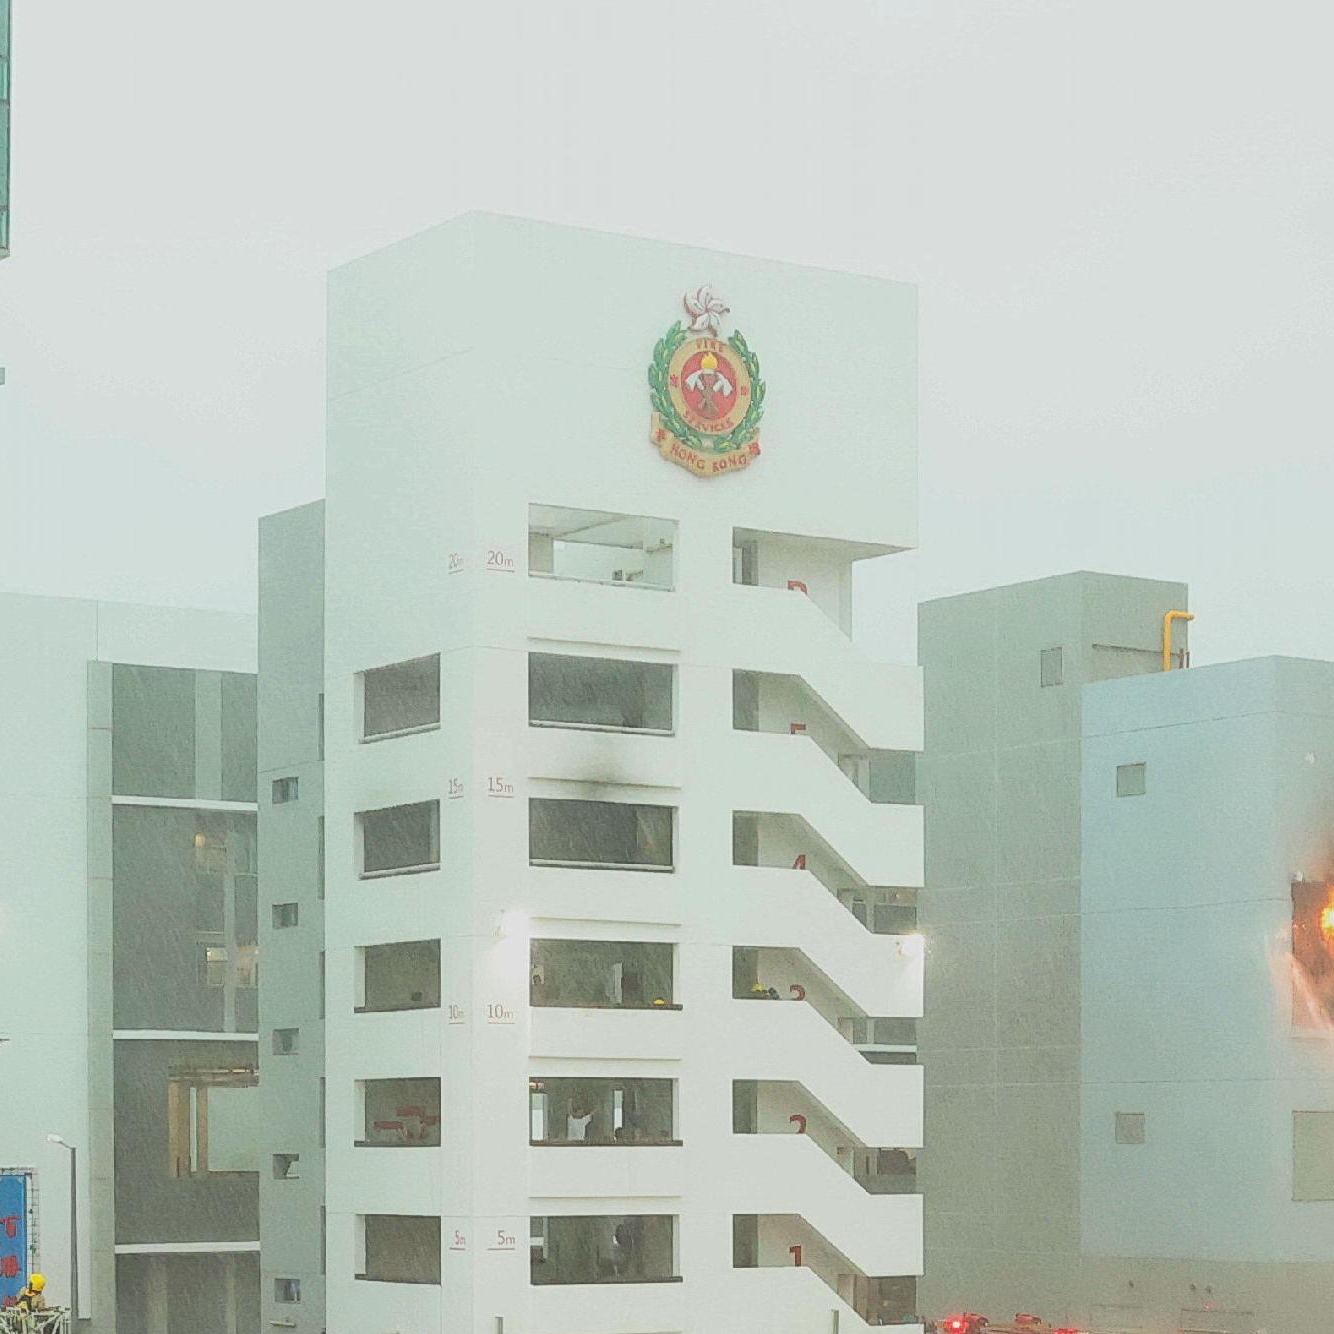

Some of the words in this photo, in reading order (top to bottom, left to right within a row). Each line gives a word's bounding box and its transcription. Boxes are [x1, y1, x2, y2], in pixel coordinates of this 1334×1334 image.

[696, 338, 724, 352] FIRE
[682, 409, 736, 433] SERVICES
[671, 443, 705, 470] HONG
[711, 454, 748, 473] KONG
[487, 550, 514, 567] 20m
[488, 777, 513, 792] 15m
[487, 1004, 514, 1018] 10m
[498, 1230, 516, 1245] 5m
